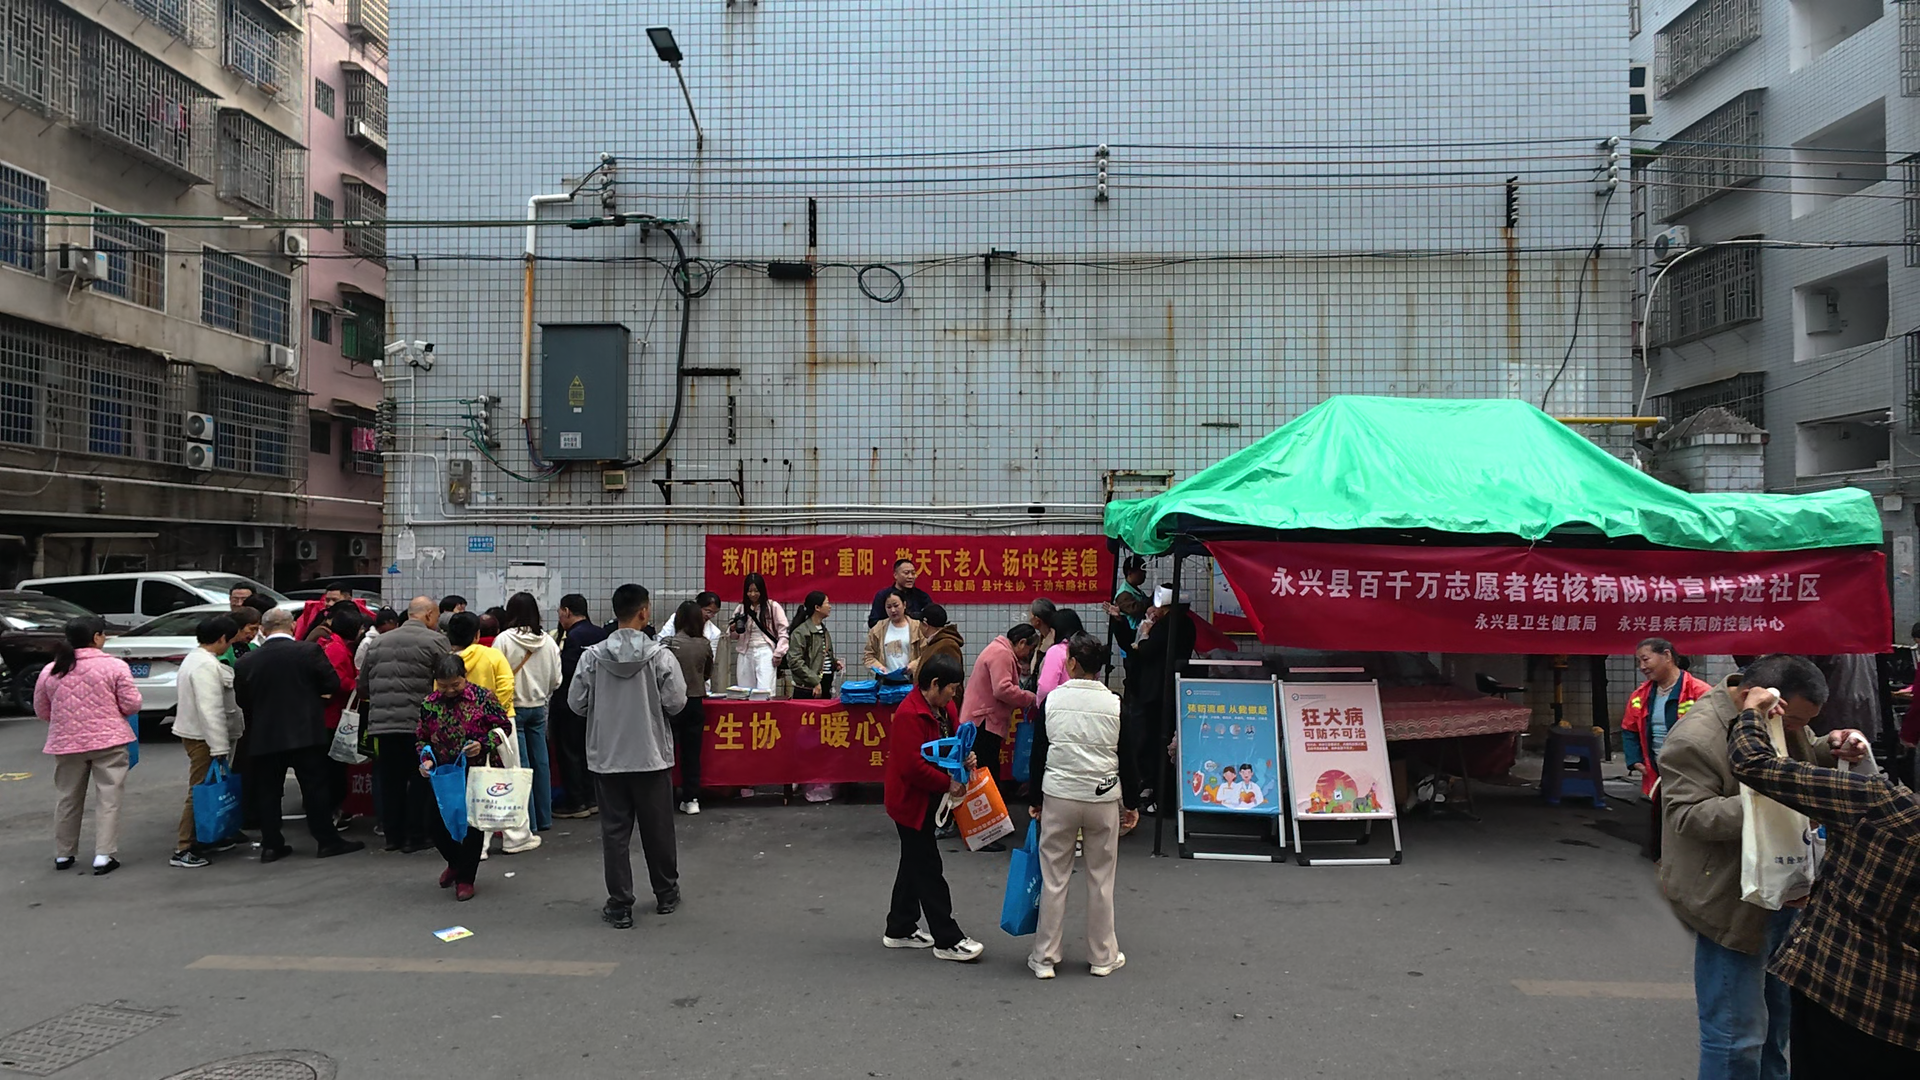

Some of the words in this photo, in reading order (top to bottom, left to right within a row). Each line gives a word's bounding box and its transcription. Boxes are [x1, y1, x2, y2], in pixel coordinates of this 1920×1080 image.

[1002, 547, 1098, 578] 扬中华美德
[931, 579, 976, 592] 县卫健局
[982, 579, 1026, 592] 县计生协
[1032, 579, 1099, 592] 干劲东路社区
[1271, 566, 1821, 604] 永兴县百千万志愿者结核病防治宣传进社区
[1475, 613, 1597, 632] 永兴县卫生健康局
[1617, 614, 1785, 632] 永兴县疾病预防控制中心
[1301, 707, 1364, 726] 狂犬病
[1303, 728, 1367, 740] 可防不可治
